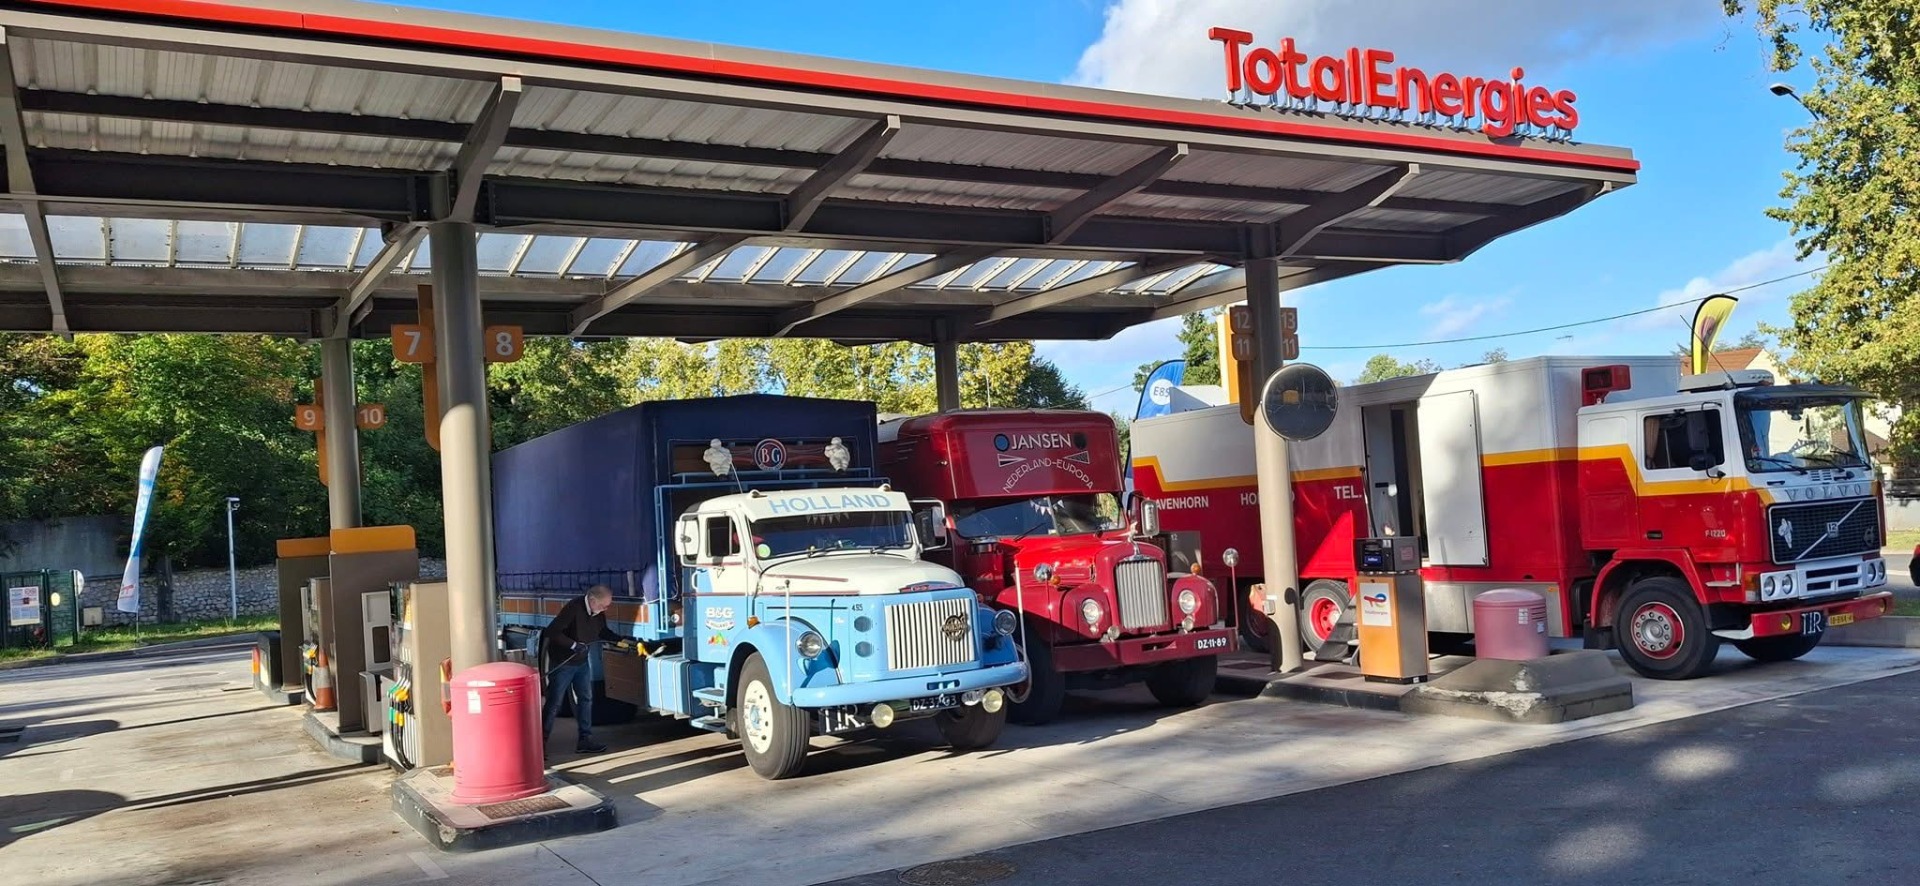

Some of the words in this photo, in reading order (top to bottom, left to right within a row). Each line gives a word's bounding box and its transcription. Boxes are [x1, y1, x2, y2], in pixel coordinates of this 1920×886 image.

[1208, 27, 1580, 138] TotalEnergies
[1235, 311, 1251, 329] 12
[1281, 312, 1296, 329] 13
[403, 331, 421, 356] 7
[495, 332, 514, 356] 8
[1236, 338, 1250, 356] 11
[1282, 338, 1296, 356] 11
[303, 409, 316, 426] 9
[359, 408, 382, 424] 10
[1011, 433, 1072, 450] JANSEN
[1003, 457, 1094, 494] NEDERLAND-EUROPA
[1333, 485, 1362, 499] TEL.
[1785, 483, 1862, 501] VOLVO
[769, 494, 892, 514] HOLLAND
[1801, 611, 1823, 635] TIR
